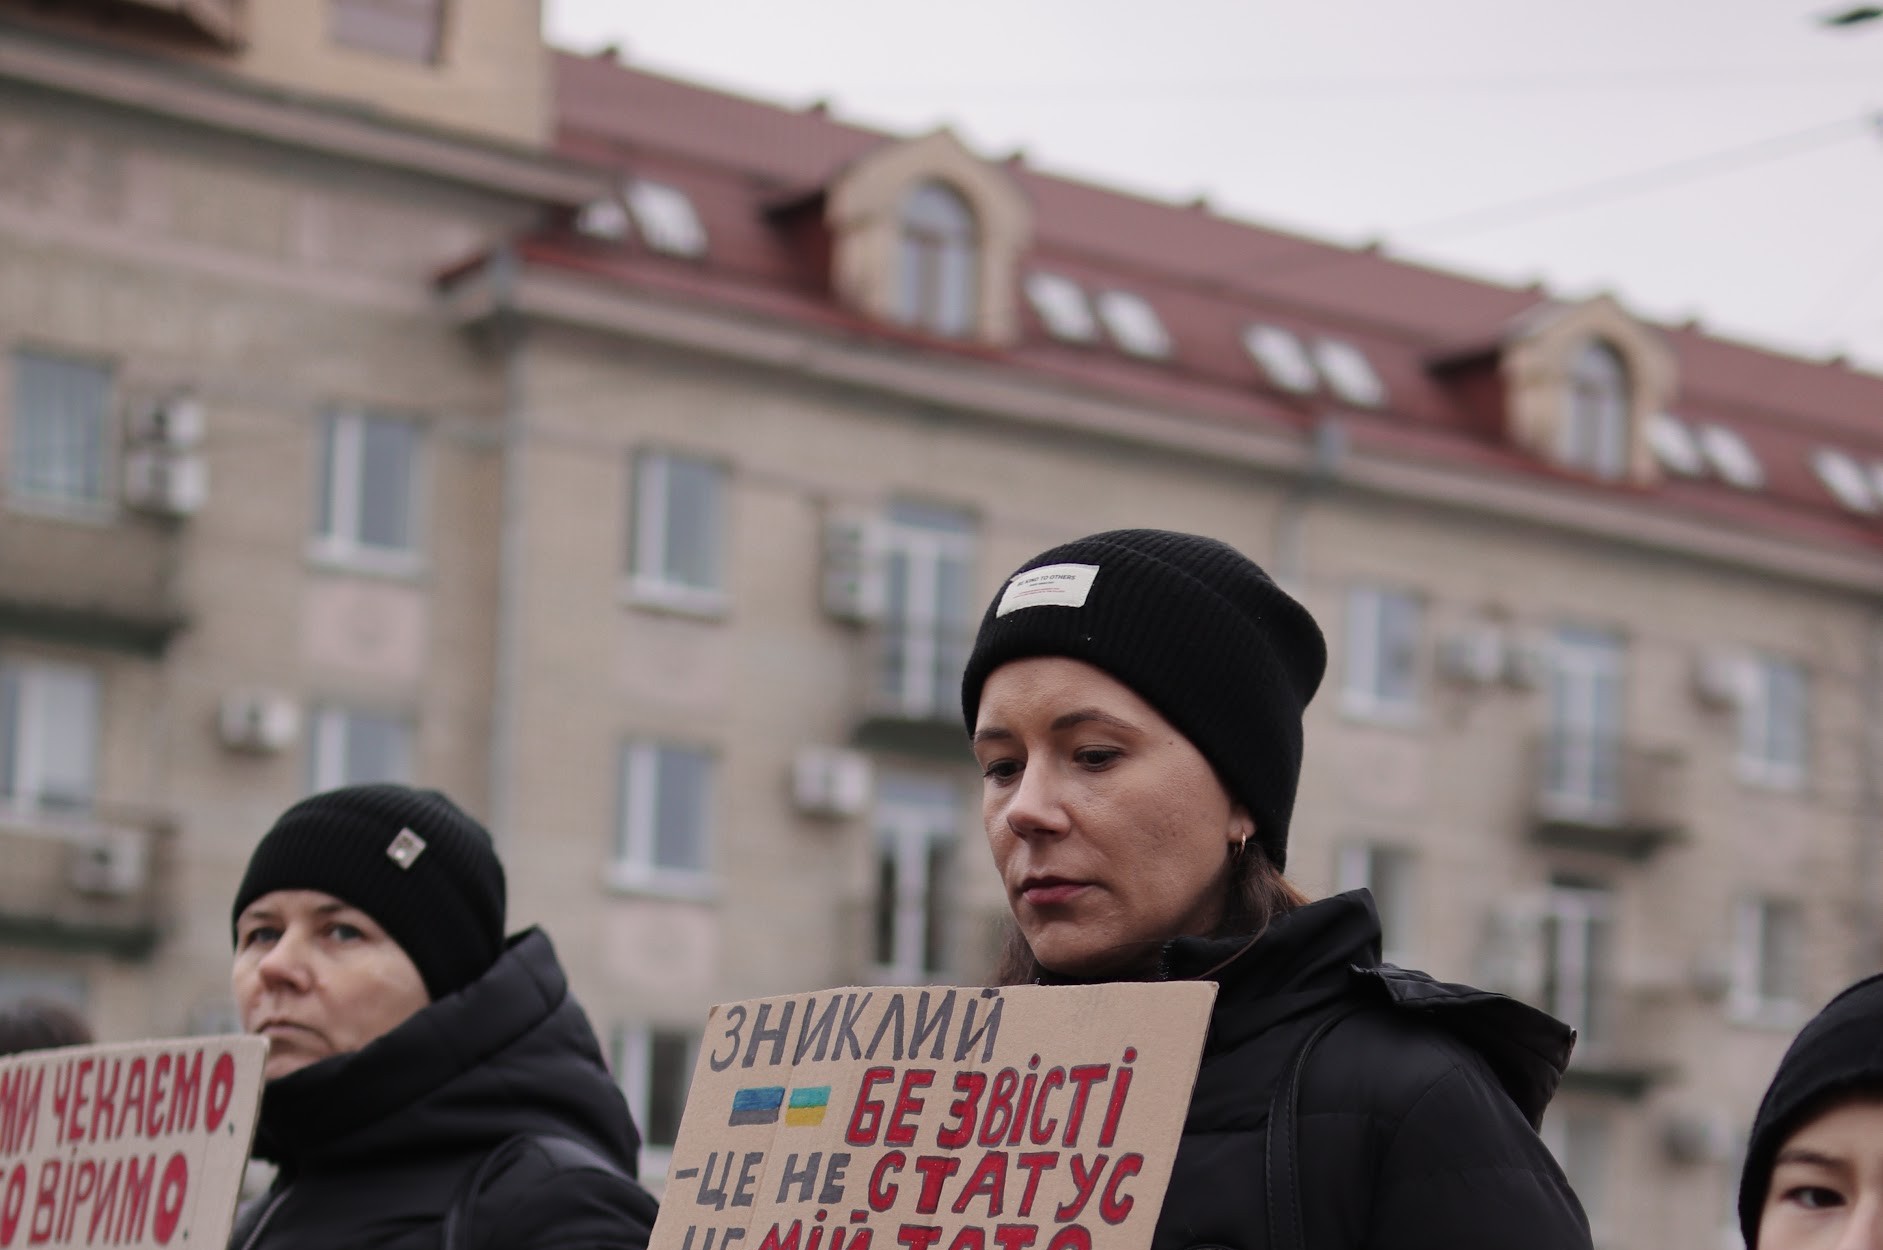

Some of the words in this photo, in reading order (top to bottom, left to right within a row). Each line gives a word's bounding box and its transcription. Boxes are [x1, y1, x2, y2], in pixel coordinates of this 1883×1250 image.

[710, 987, 1005, 1072] ЗНИКЛИЙ
[776, 1151, 851, 1204] НЕ
[867, 1150, 1143, 1225] СТАТУС
